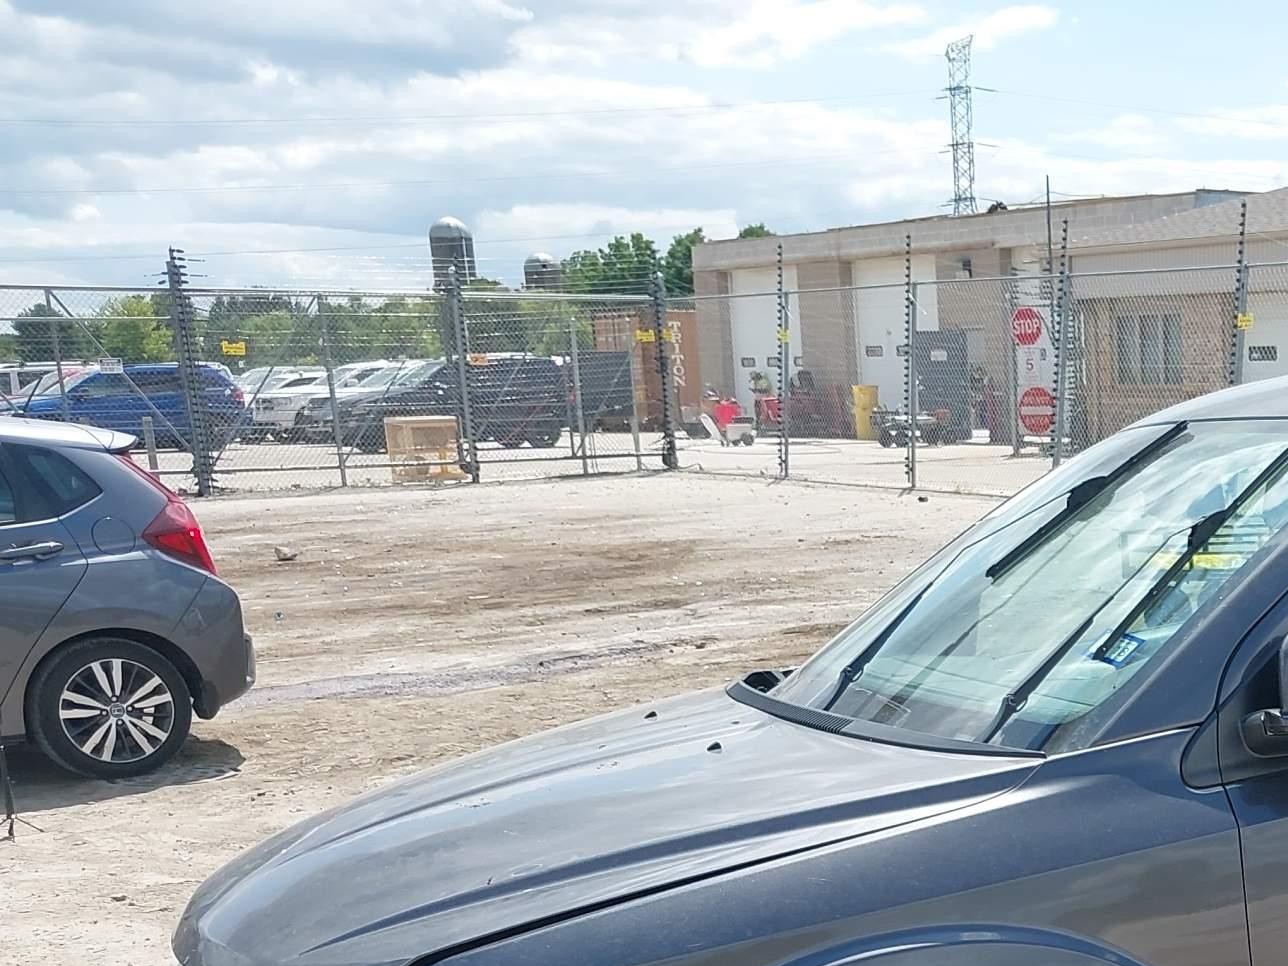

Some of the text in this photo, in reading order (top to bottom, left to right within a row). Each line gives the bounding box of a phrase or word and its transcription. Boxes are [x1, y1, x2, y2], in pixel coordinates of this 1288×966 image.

[1013, 319, 1039, 335] STOP
[668, 321, 687, 387] TRITON
[1025, 358, 1034, 371] 5
